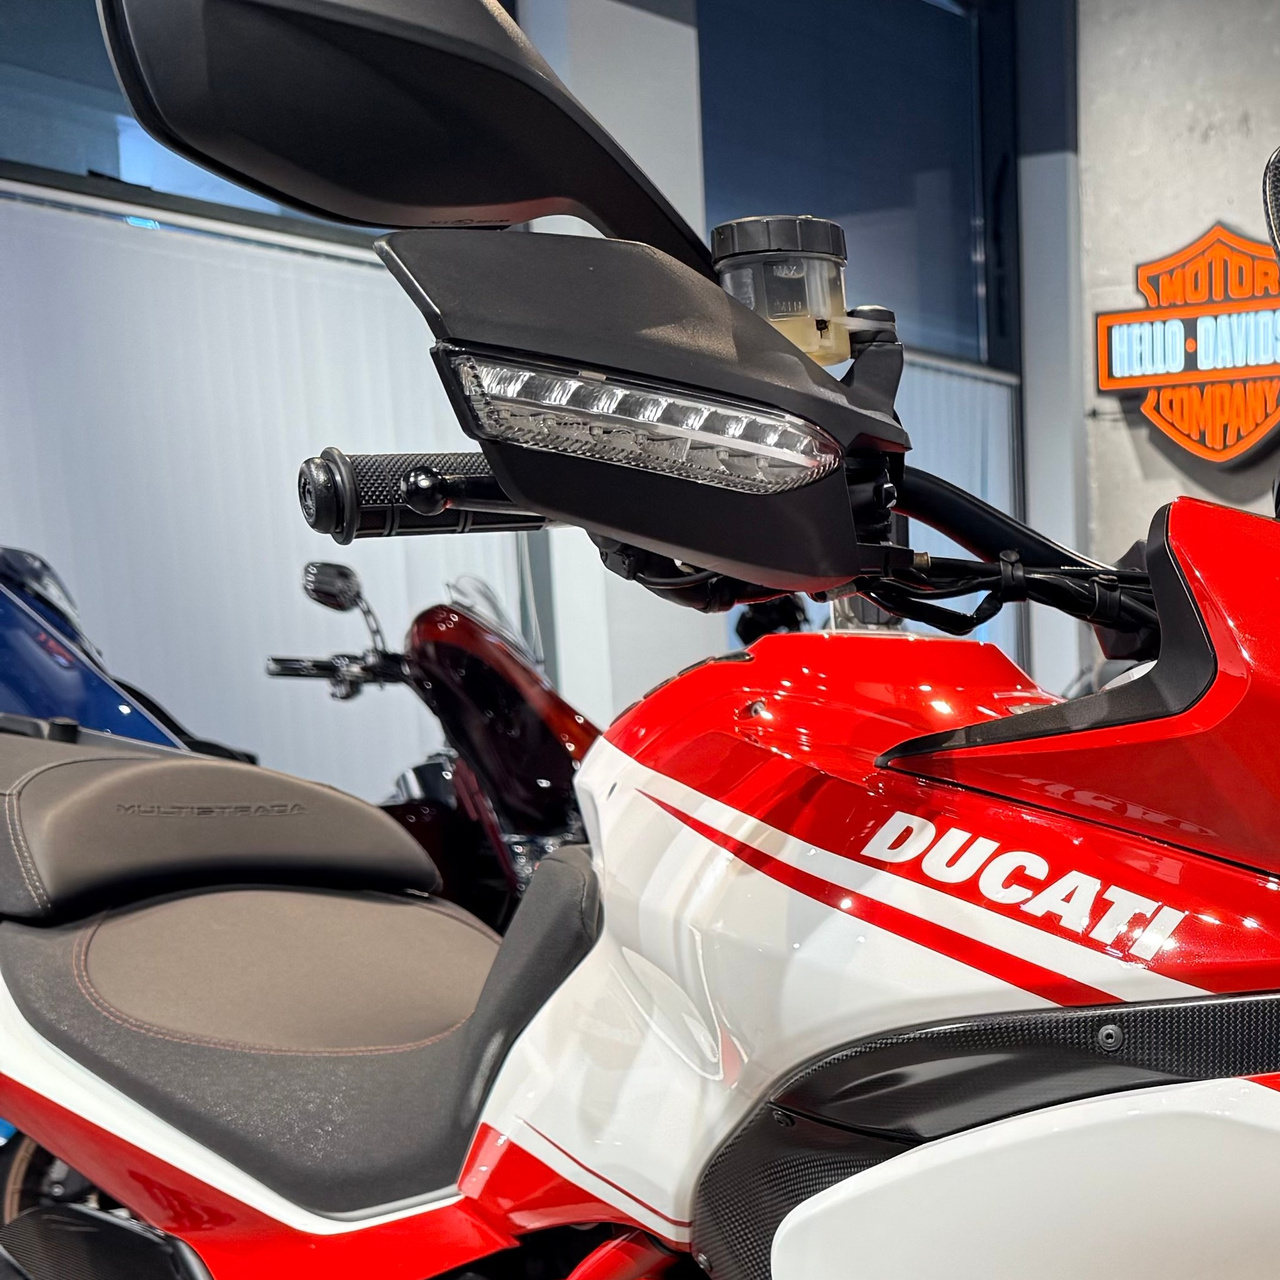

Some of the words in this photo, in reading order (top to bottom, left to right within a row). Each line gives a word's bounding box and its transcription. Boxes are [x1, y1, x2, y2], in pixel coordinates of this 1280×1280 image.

[1159, 242, 1280, 306] MOTOR
[1159, 379, 1280, 450] COMPANY
[860, 811, 1188, 962] DUCATI
